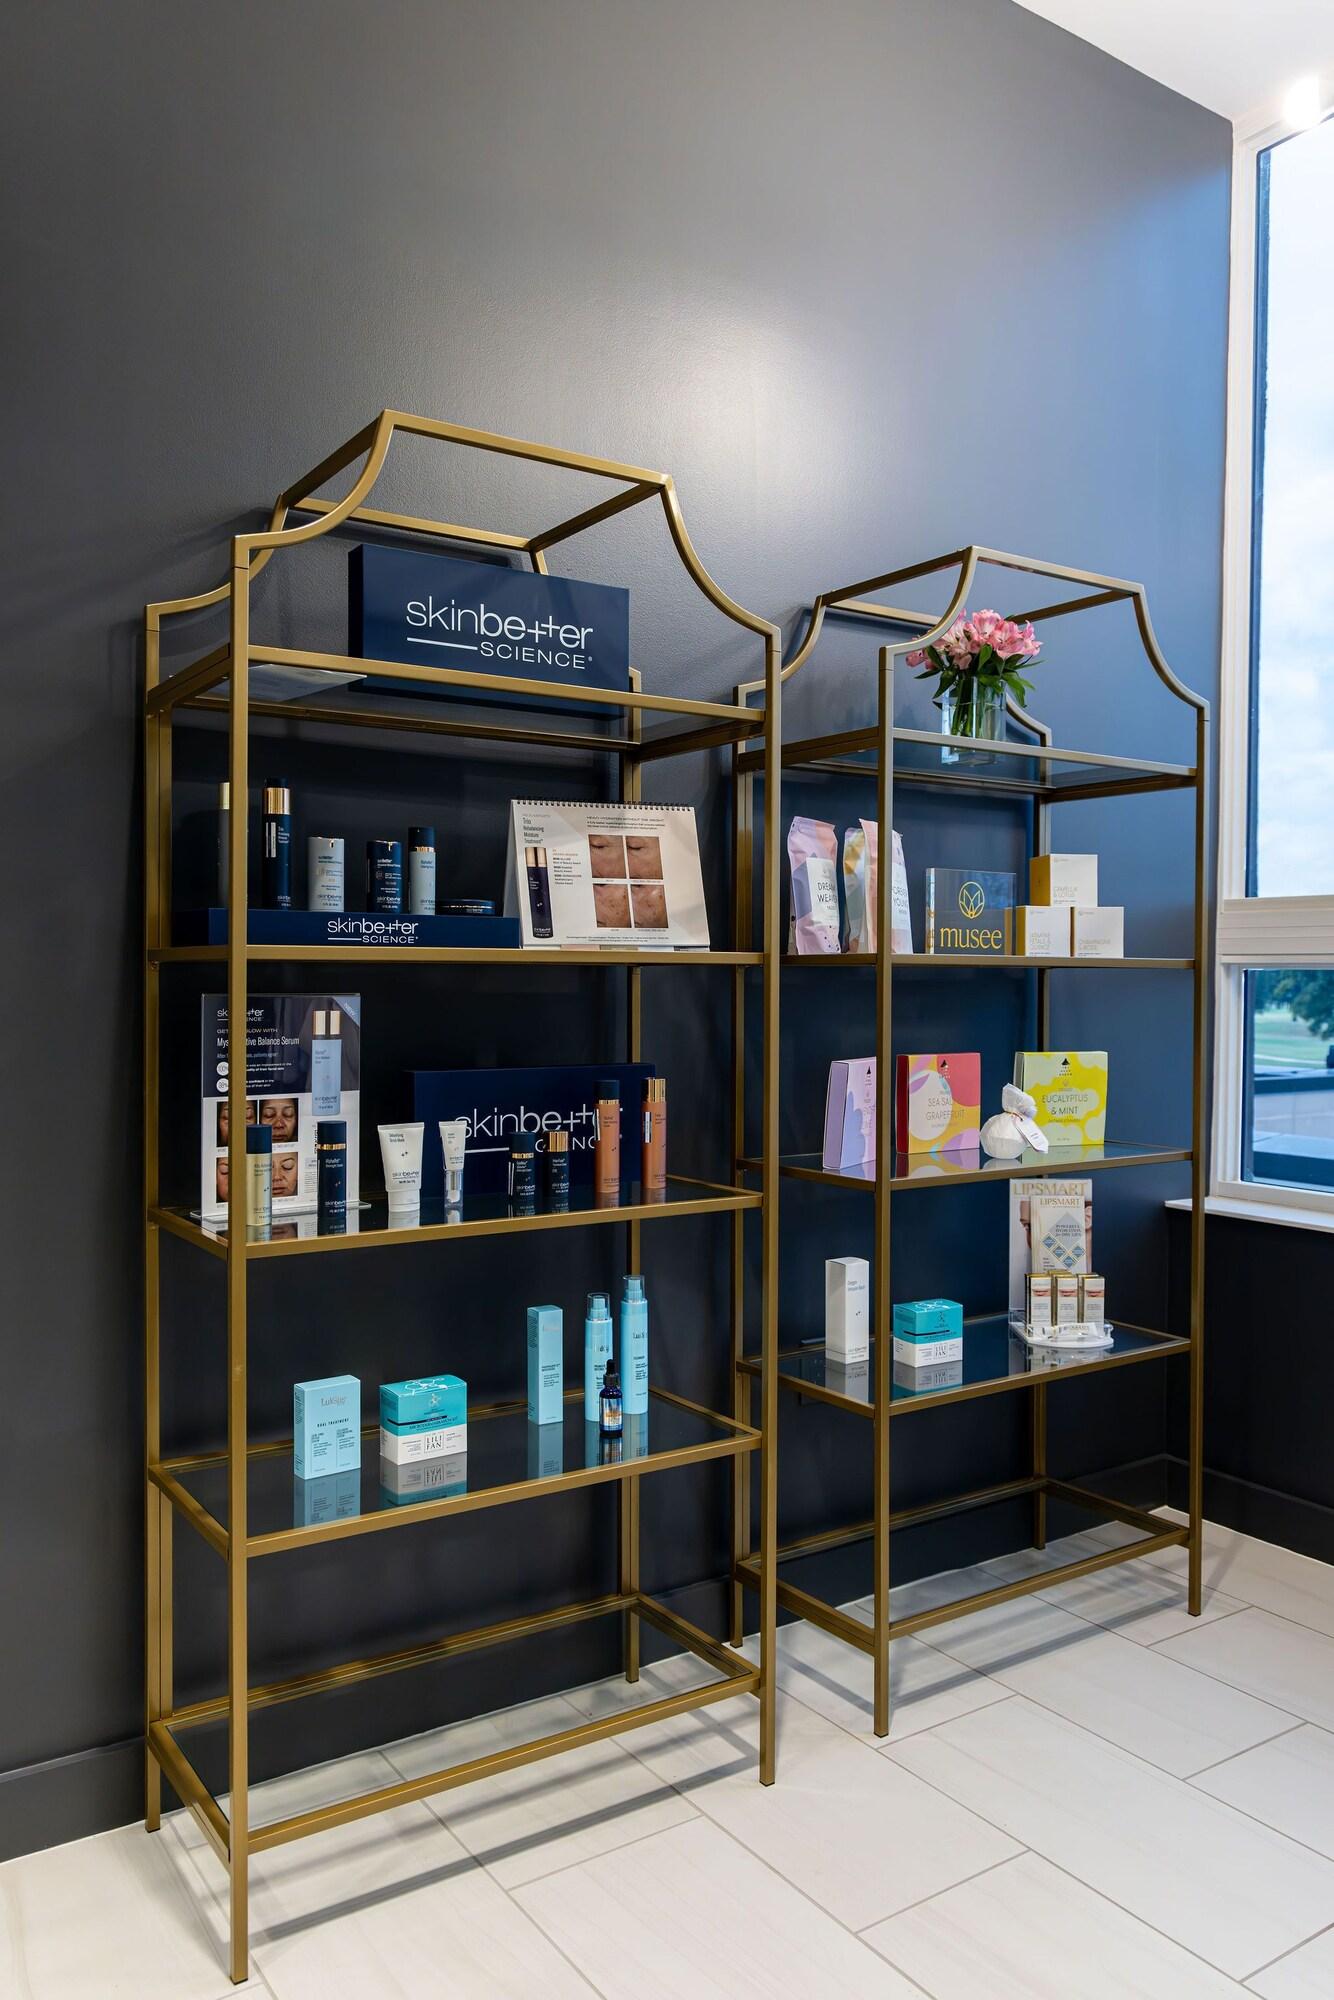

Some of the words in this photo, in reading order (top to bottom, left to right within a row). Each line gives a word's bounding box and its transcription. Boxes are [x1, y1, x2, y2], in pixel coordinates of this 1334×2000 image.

[405, 595, 594, 650] skinbetter
[327, 917, 419, 935] skinbetter
[940, 927, 1002, 949] musee
[257, 1036, 280, 1046] Balance
[281, 1035, 300, 1046] Serum
[1042, 1094, 1089, 1104] EUCALYPTUS
[1059, 1106, 1079, 1115] MINT
[1012, 1182, 1088, 1196] LIPSMART
[1040, 1198, 1081, 1206] LIPSMART
[426, 1435, 442, 1444] LILI
[426, 1442, 441, 1450] FAN
